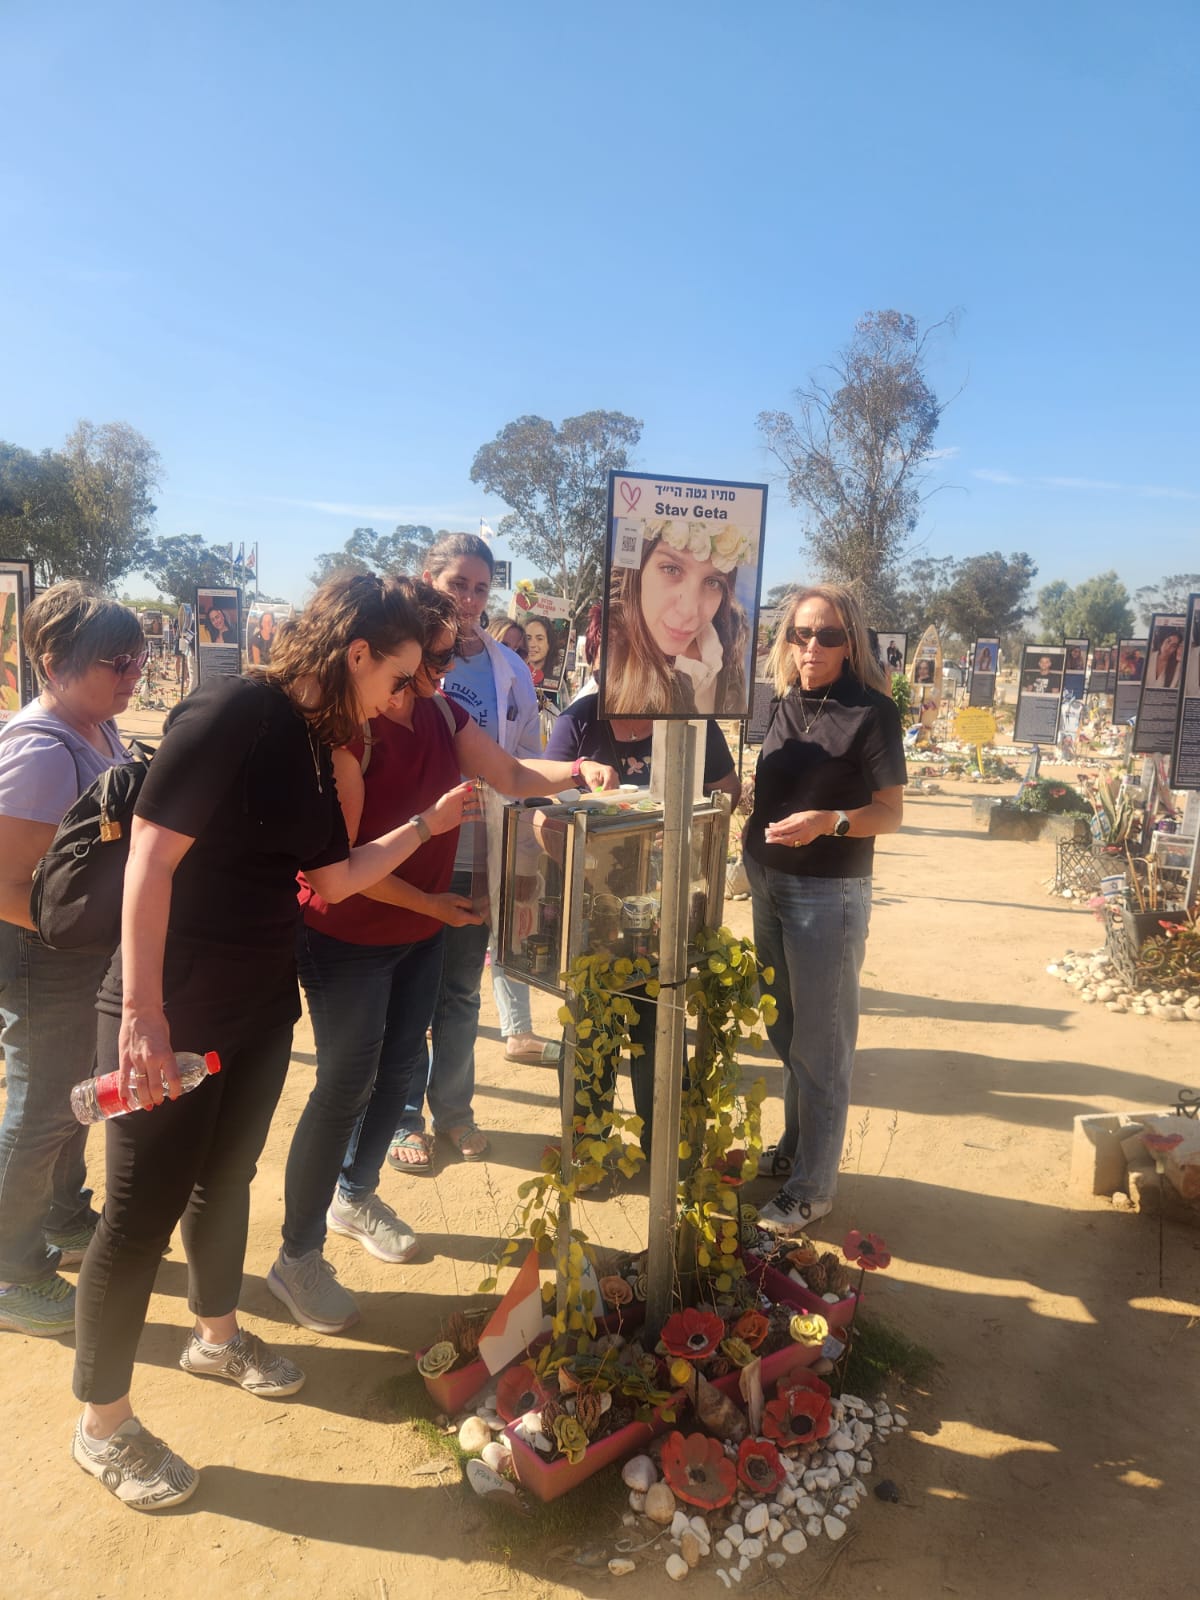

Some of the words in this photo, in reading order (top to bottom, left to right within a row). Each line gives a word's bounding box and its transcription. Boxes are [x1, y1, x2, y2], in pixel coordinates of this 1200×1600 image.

[686, 487, 707, 499] גטה
[711, 489, 736, 501] סתיו
[655, 502, 688, 516] Stav
[693, 505, 728, 520] Geta
